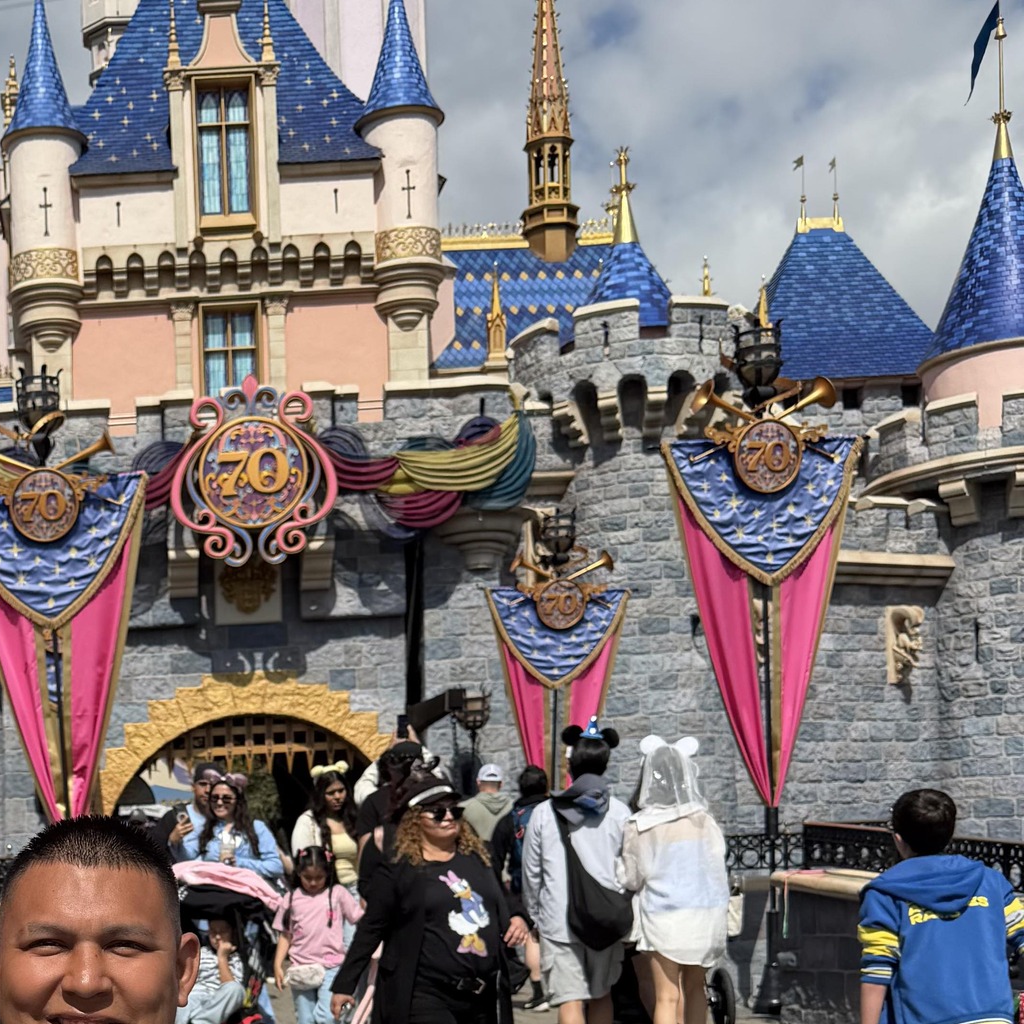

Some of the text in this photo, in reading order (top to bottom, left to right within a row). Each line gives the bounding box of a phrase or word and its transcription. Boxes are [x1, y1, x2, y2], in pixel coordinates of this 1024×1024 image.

[748, 441, 789, 471] 70
[217, 448, 289, 496] 70
[20, 490, 66, 521] 70
[545, 592, 577, 614] 70
